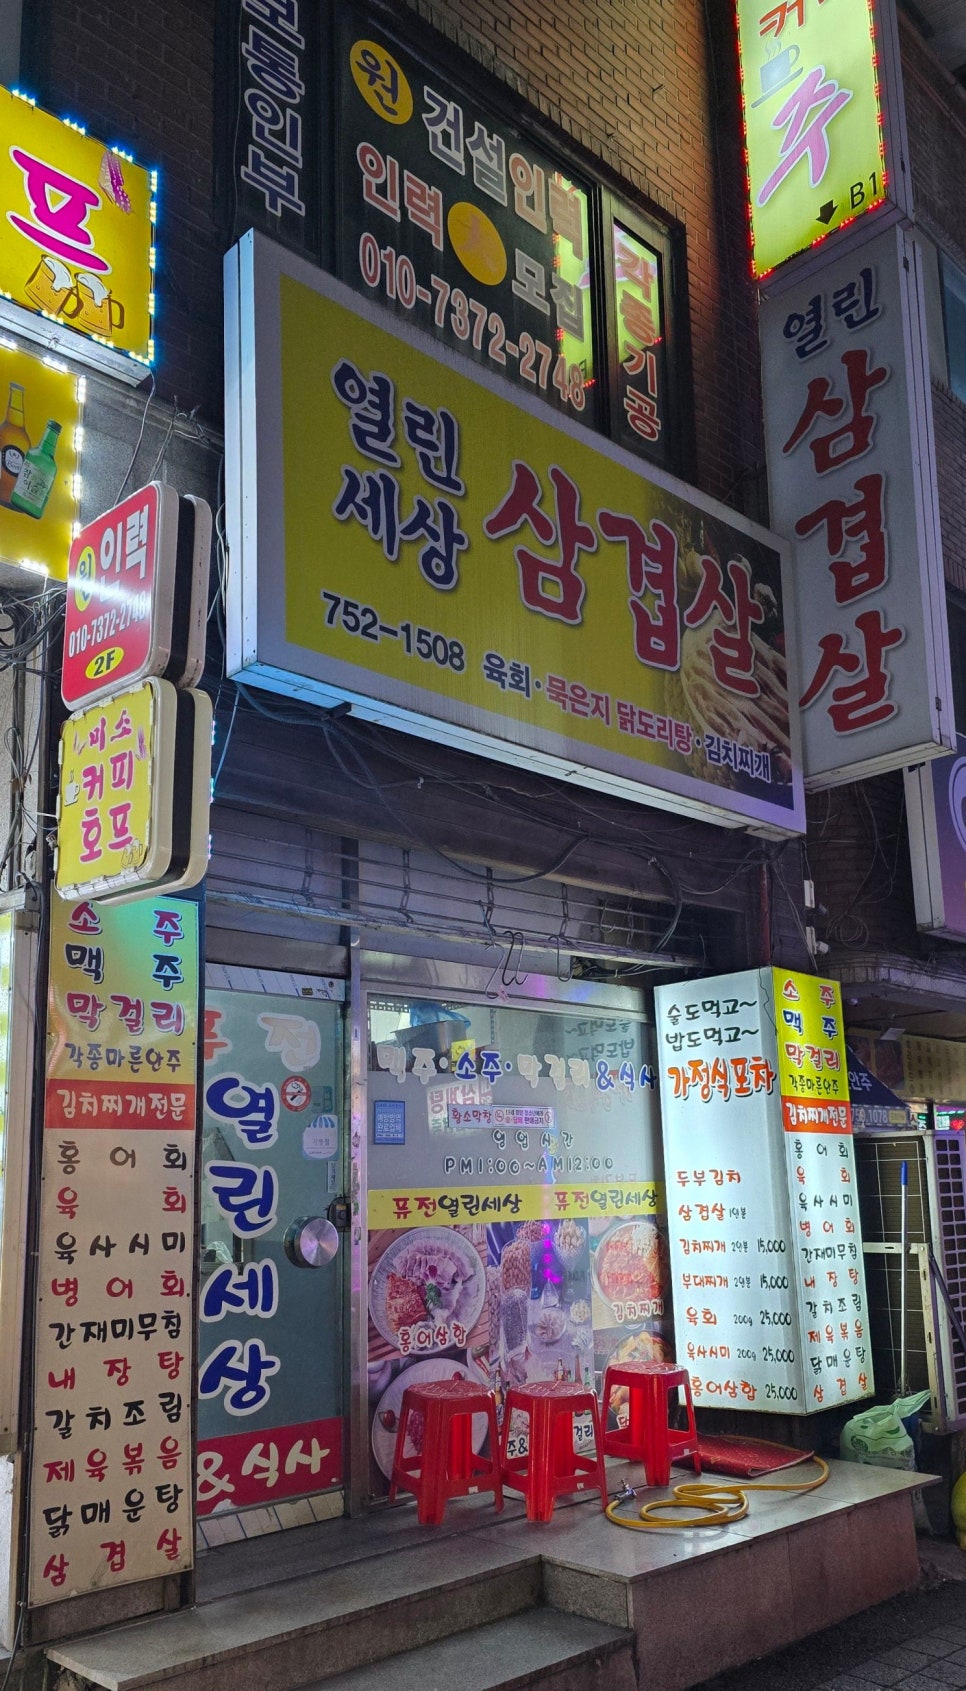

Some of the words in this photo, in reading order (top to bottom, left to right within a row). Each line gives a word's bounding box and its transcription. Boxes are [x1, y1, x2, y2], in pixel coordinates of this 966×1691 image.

[850, 172, 878, 210] B1
[356, 142, 443, 251] 인력
[512, 248, 584, 342] 모집
[359, 231, 586, 411] 010-7372-2748
[782, 267, 881, 358] 열린
[331, 358, 466, 496] 열린
[333, 465, 468, 590] 세상
[782, 350, 905, 735] 삼겹살
[483, 460, 765, 699] 삼겹살
[321, 591, 466, 673] 752-1508
[93, 649, 116, 677] 2F
[81, 749, 135, 801] 커피
[80, 802, 133, 864] 호프
[668, 1057, 777, 1103] 가정식포차
[679, 1239, 726, 1254] 김치찌개
[757, 1238, 786, 1254] 15,000
[682, 1273, 728, 1289] 부대찌개
[760, 1273, 789, 1290] 15,000
[686, 1306, 717, 1326] 육회
[733, 1314, 753, 1327] 200g
[759, 1309, 792, 1326] 25,000
[737, 1348, 757, 1362] 200g
[763, 1346, 795, 1363] 25,000
[765, 1383, 798, 1400] 25,000
